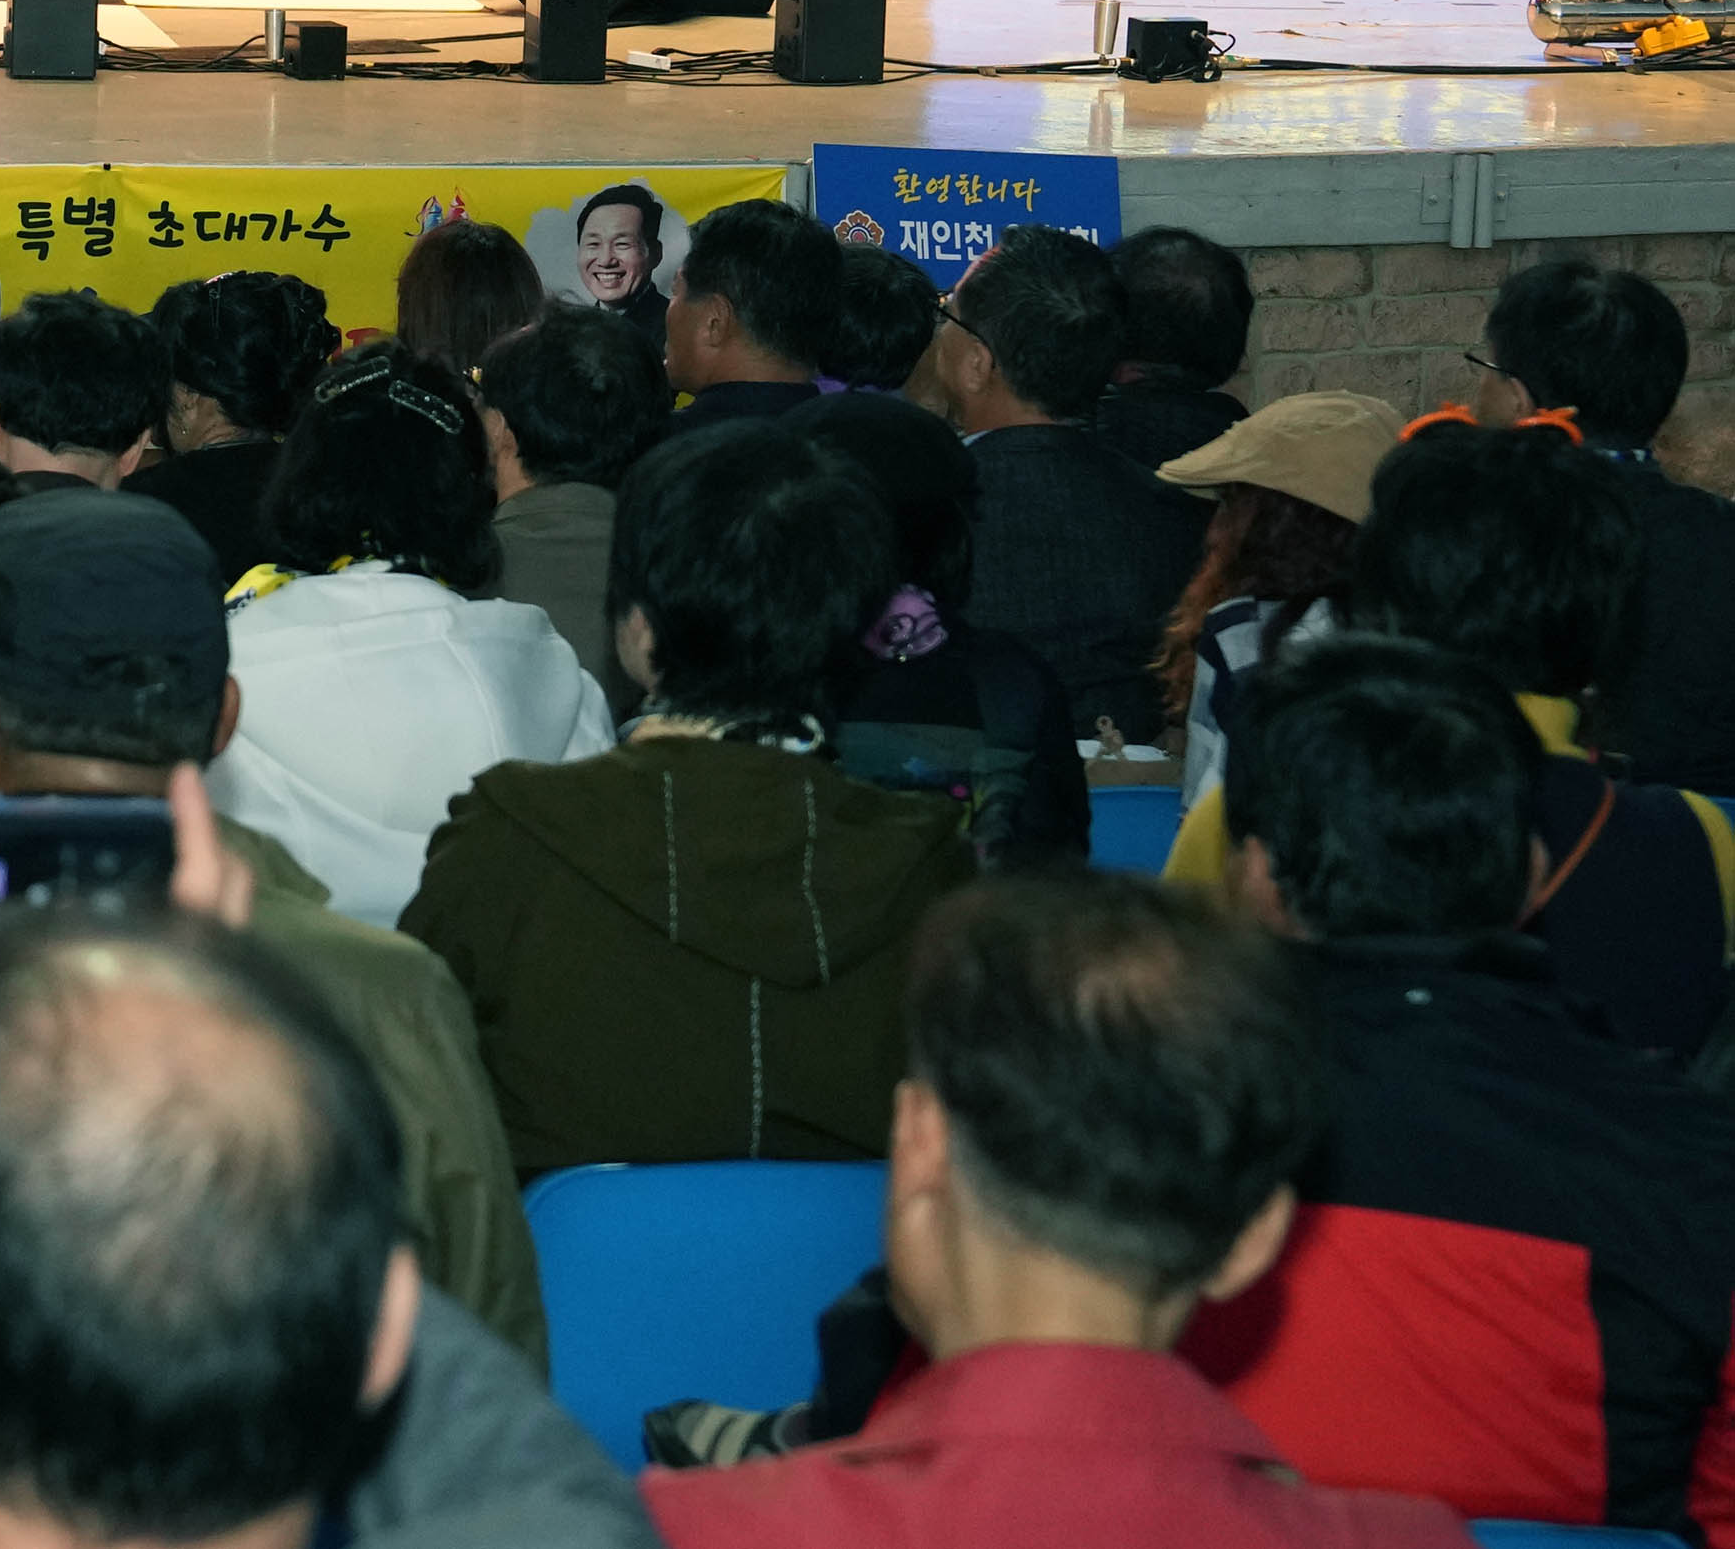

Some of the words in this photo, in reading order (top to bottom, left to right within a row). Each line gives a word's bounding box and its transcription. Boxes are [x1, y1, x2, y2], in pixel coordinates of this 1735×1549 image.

[893, 168, 1041, 212] 환영합니다
[15, 195, 116, 260] 특별
[146, 201, 351, 253] 초대가수
[898, 219, 994, 263] 재인천
